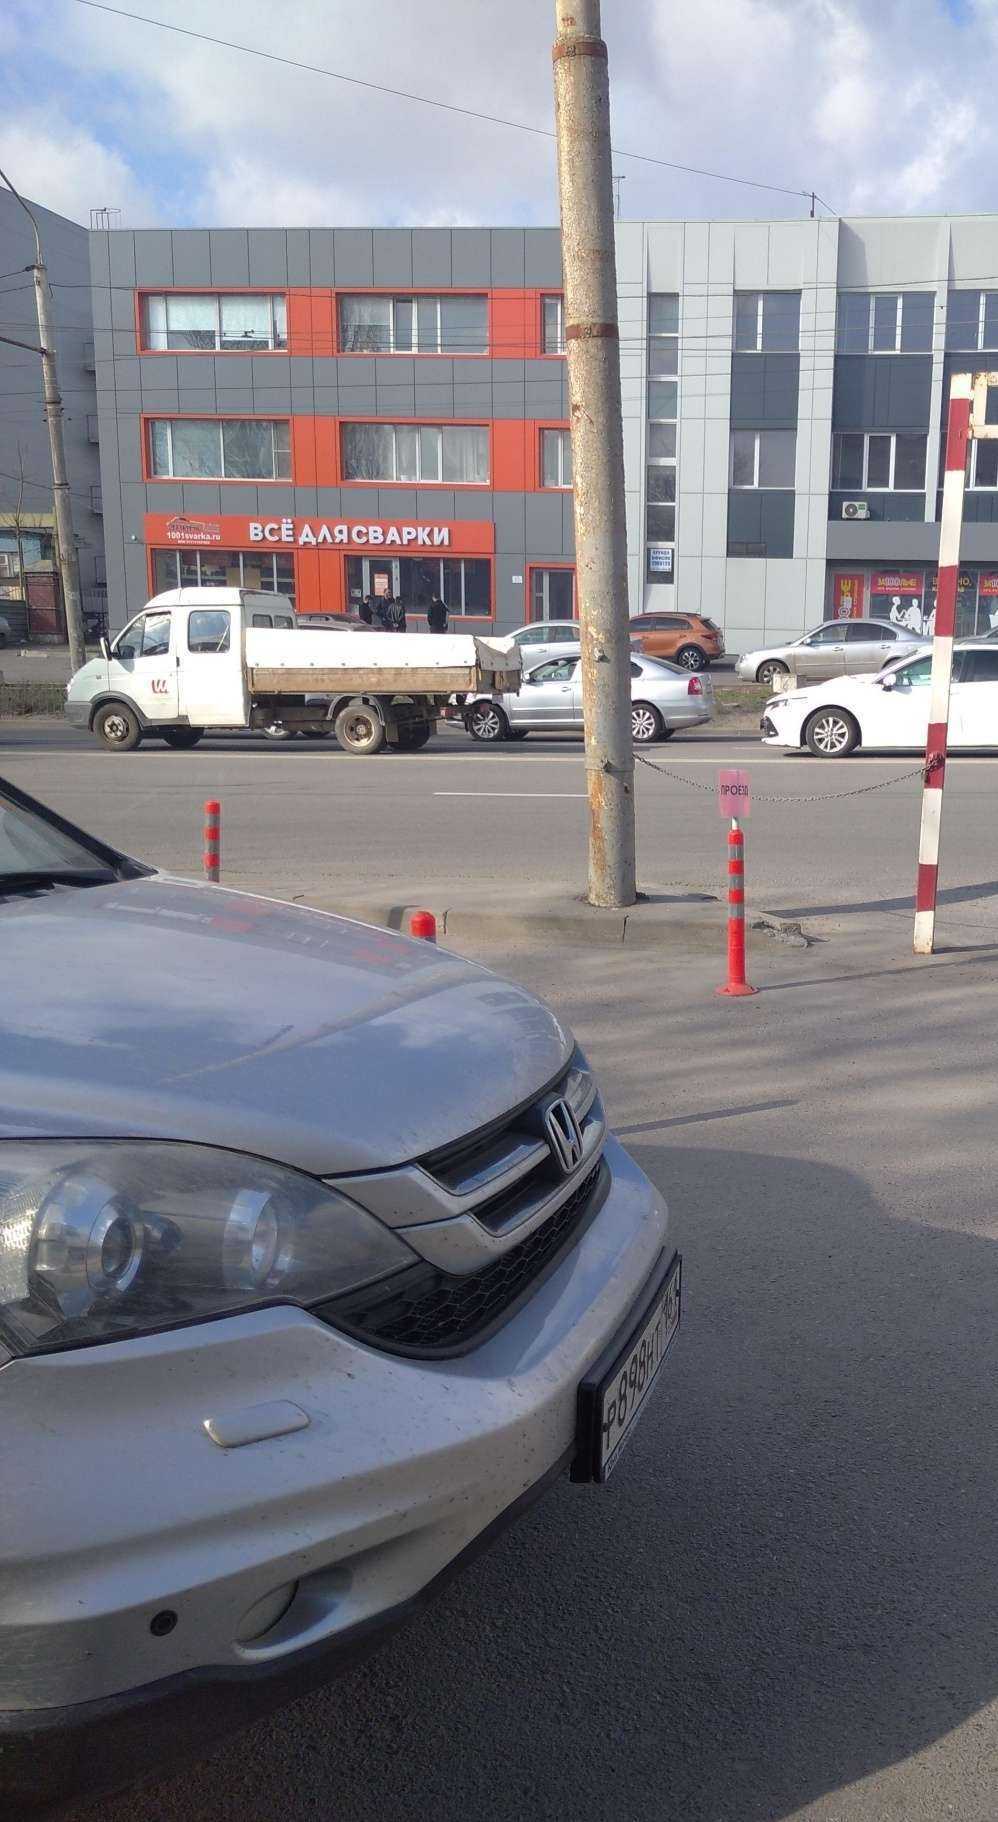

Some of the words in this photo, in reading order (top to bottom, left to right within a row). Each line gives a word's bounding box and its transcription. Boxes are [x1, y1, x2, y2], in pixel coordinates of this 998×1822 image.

[167, 531, 221, 541] 1001svarka.ru
[249, 518, 294, 542] ВСЁ
[299, 524, 348, 546] ДЛЯ
[351, 525, 450, 545] СВАРКИ
